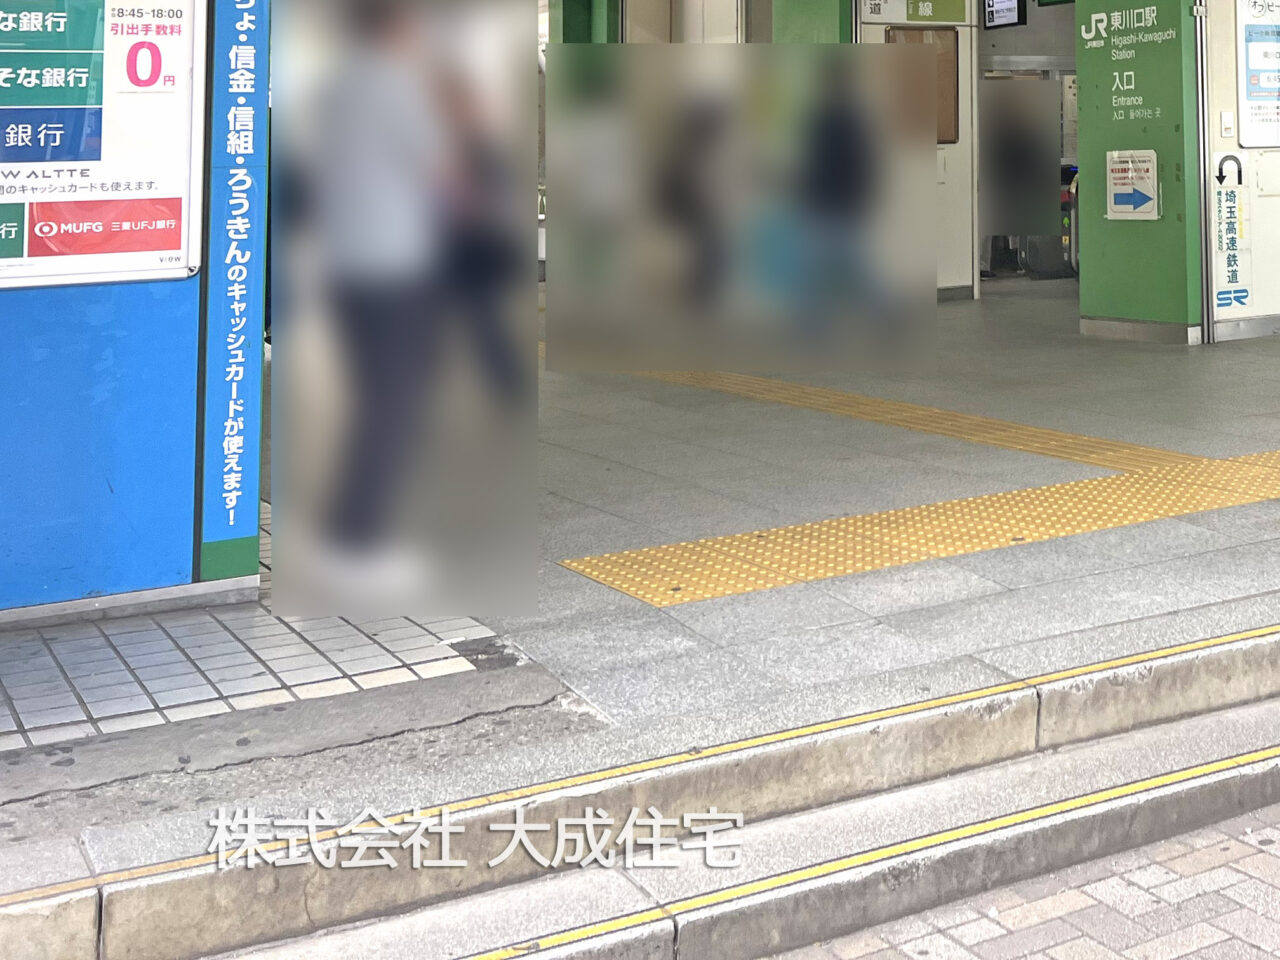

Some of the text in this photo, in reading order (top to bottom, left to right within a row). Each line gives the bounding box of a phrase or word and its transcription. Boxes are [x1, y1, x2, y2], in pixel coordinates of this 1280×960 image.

[1081, 12, 1108, 40] JR
[1110, 6, 1157, 31] 東川口駅
[110, 23, 182, 36] 引出手数料
[1111, 27, 1177, 48] Higashi-Kawaguchi
[1112, 49, 1135, 61] Station
[1112, 71, 1135, 91] 入口
[1112, 95, 1143, 107] Entrance
[5, 123, 65, 147] 銀行
[0, 181, 159, 195] のキャッシュカードも使えます。
[60, 221, 104, 234] MUFG
[1225, 190, 1239, 284] 埼玉高速鉄道
[1217, 288, 1249, 307] SR
